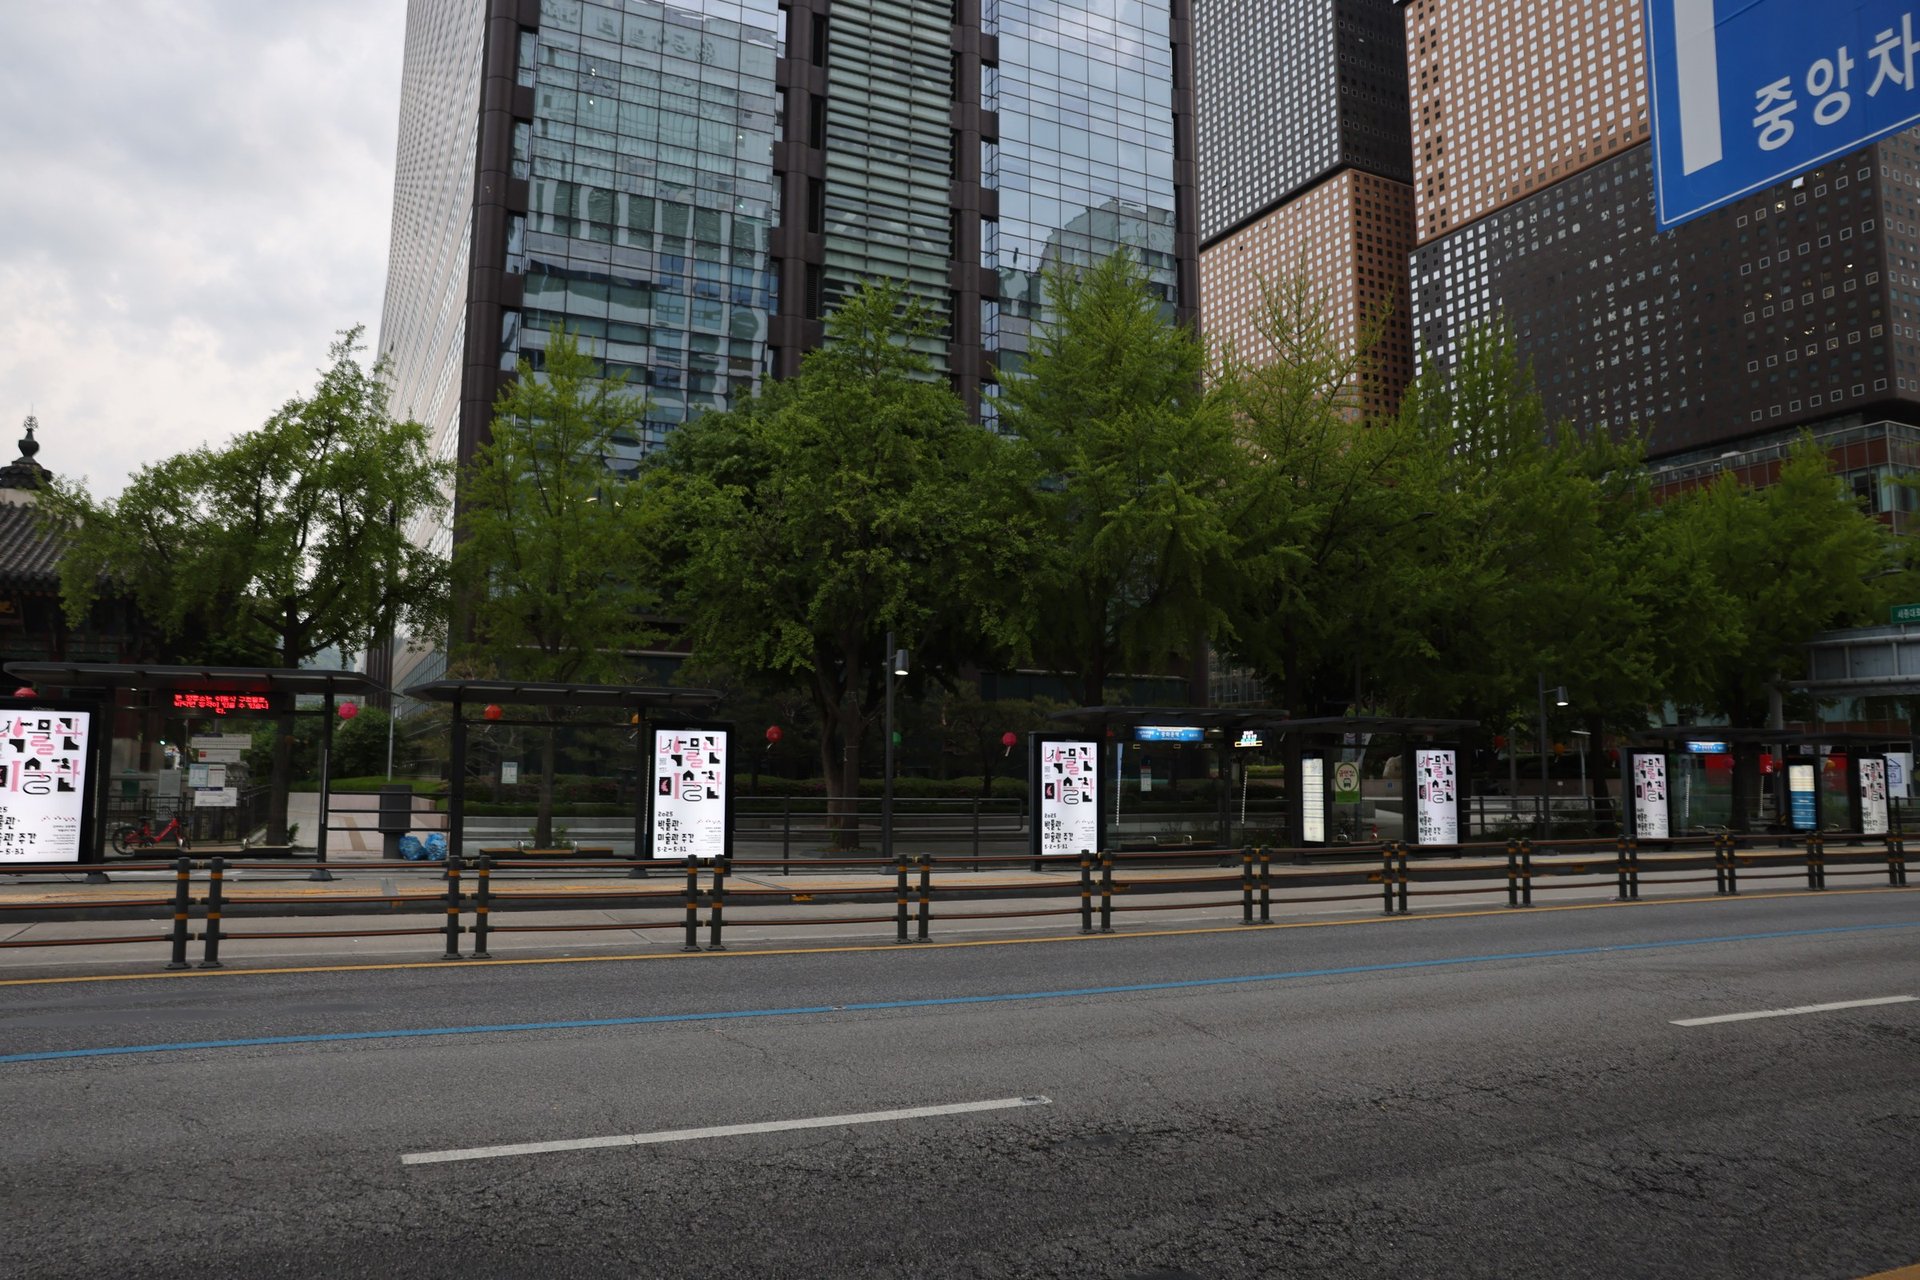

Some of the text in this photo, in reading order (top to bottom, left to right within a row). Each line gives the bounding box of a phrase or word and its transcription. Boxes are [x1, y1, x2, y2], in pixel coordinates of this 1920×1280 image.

[19, 833, 37, 844] 주간
[657, 832, 679, 845] 미술관
[682, 833, 694, 843] 주간
